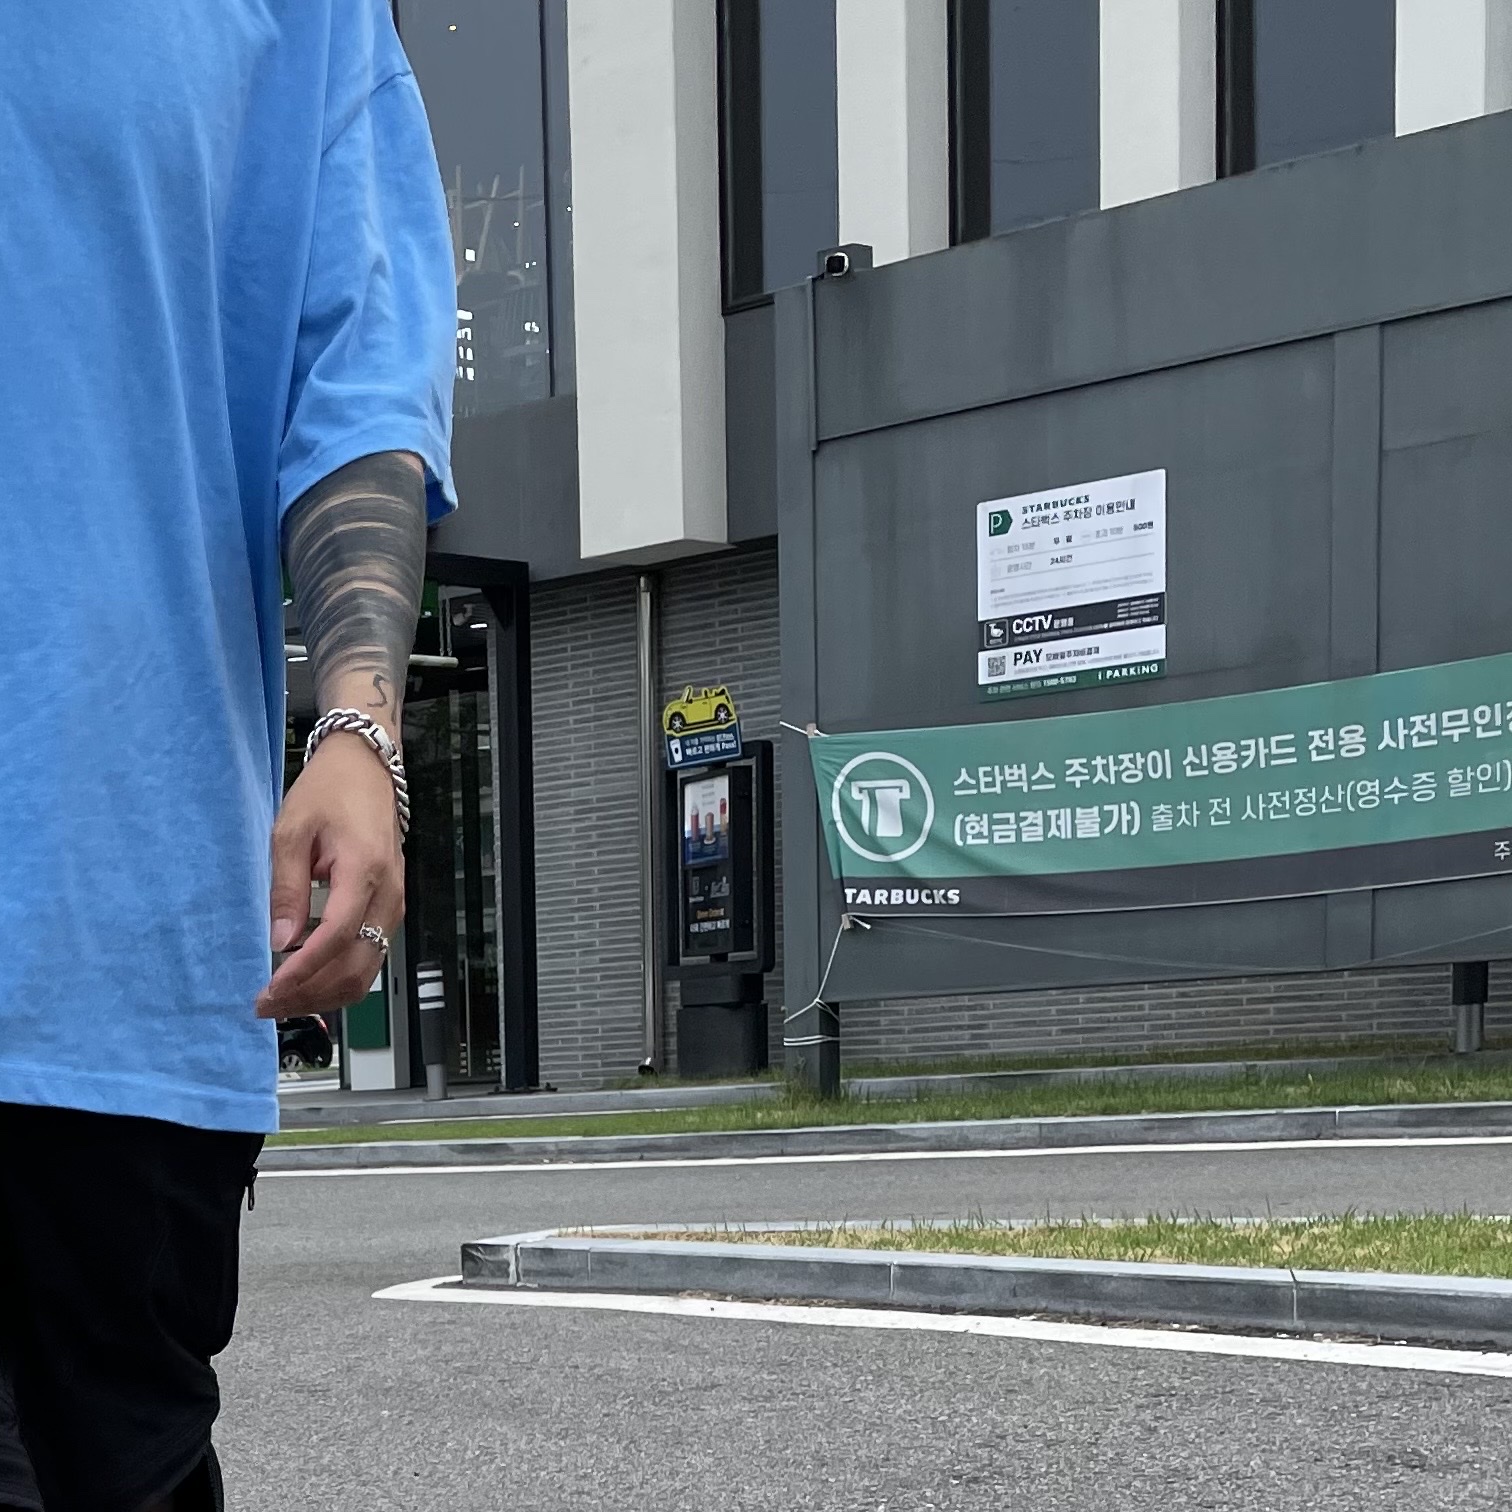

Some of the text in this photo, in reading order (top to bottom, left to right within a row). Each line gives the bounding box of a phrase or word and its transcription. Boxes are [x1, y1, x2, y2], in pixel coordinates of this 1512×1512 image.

[1021, 494, 1090, 515] STARBUCKS
[1021, 498, 1136, 530] 스타벅스 주차장 이용안내
[1012, 613, 1053, 635] CCTV
[1013, 648, 1043, 667] PAY
[1106, 663, 1159, 680] PARKING
[953, 761, 1056, 796] 스타벅스
[1065, 748, 1172, 789] 주차장이
[1182, 734, 1298, 777] 신용카드
[1308, 724, 1367, 762] 전용
[954, 759, 1512, 847] (현금결제불가) 출차 전 사전정산(영수증 할인)
[844, 888, 960, 905] TARBUCKS
